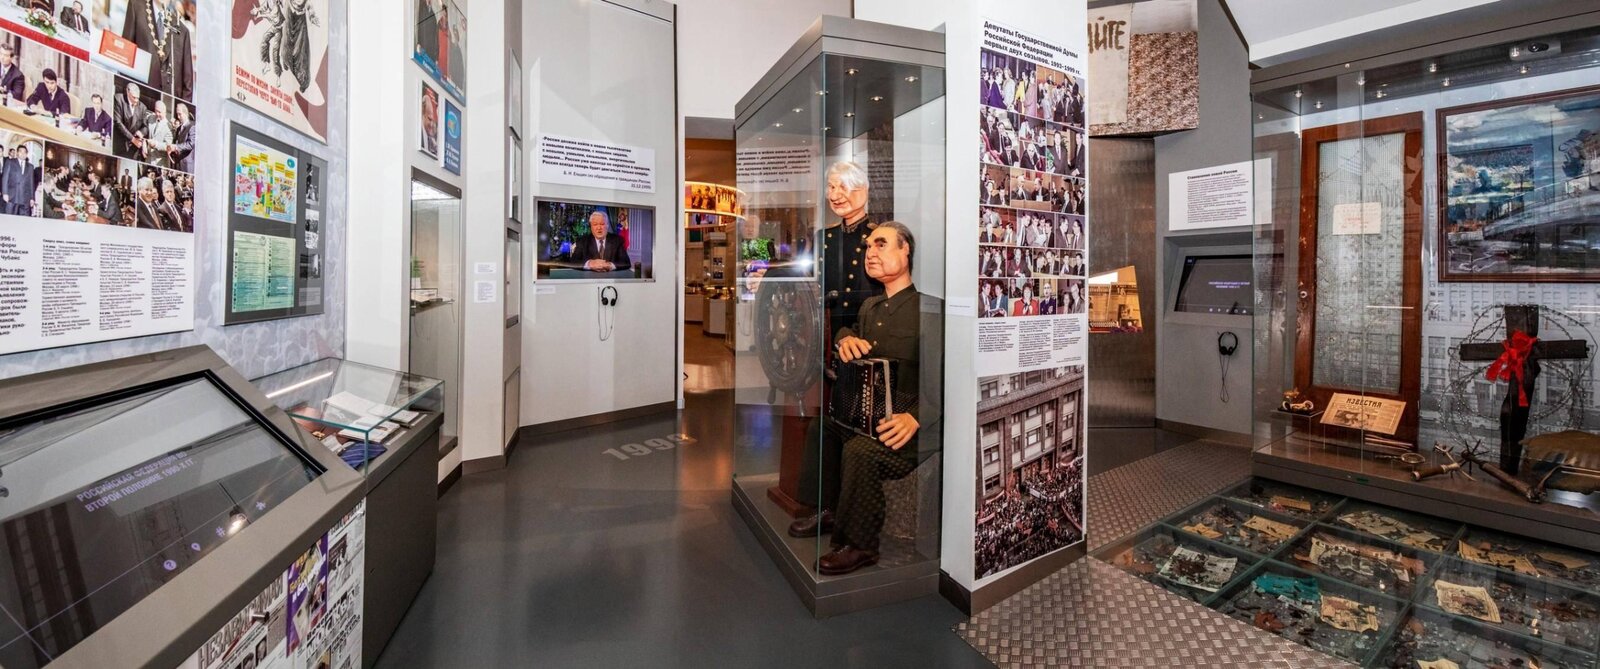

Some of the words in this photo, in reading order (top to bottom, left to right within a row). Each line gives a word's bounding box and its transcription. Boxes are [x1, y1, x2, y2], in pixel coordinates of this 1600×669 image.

[984, 21, 1014, 36] Депутаты
[1015, 31, 1062, 53] Государственной
[1063, 47, 1078, 59] Думы
[984, 30, 1021, 48] Российской
[1022, 42, 1054, 58] Федерации
[984, 39, 1008, 51] первых
[1009, 47, 1022, 57] двух
[1346, 397, 1383, 408] ИЗВЕСТИЯ
[76, 473, 135, 502] РОССИЙСКАЯ
[134, 455, 178, 477] ФЕДЕРАЦИЯ
[85, 490, 123, 512] ВТОРОЙ
[122, 473, 163, 496] ПОЛОВИНЕ
